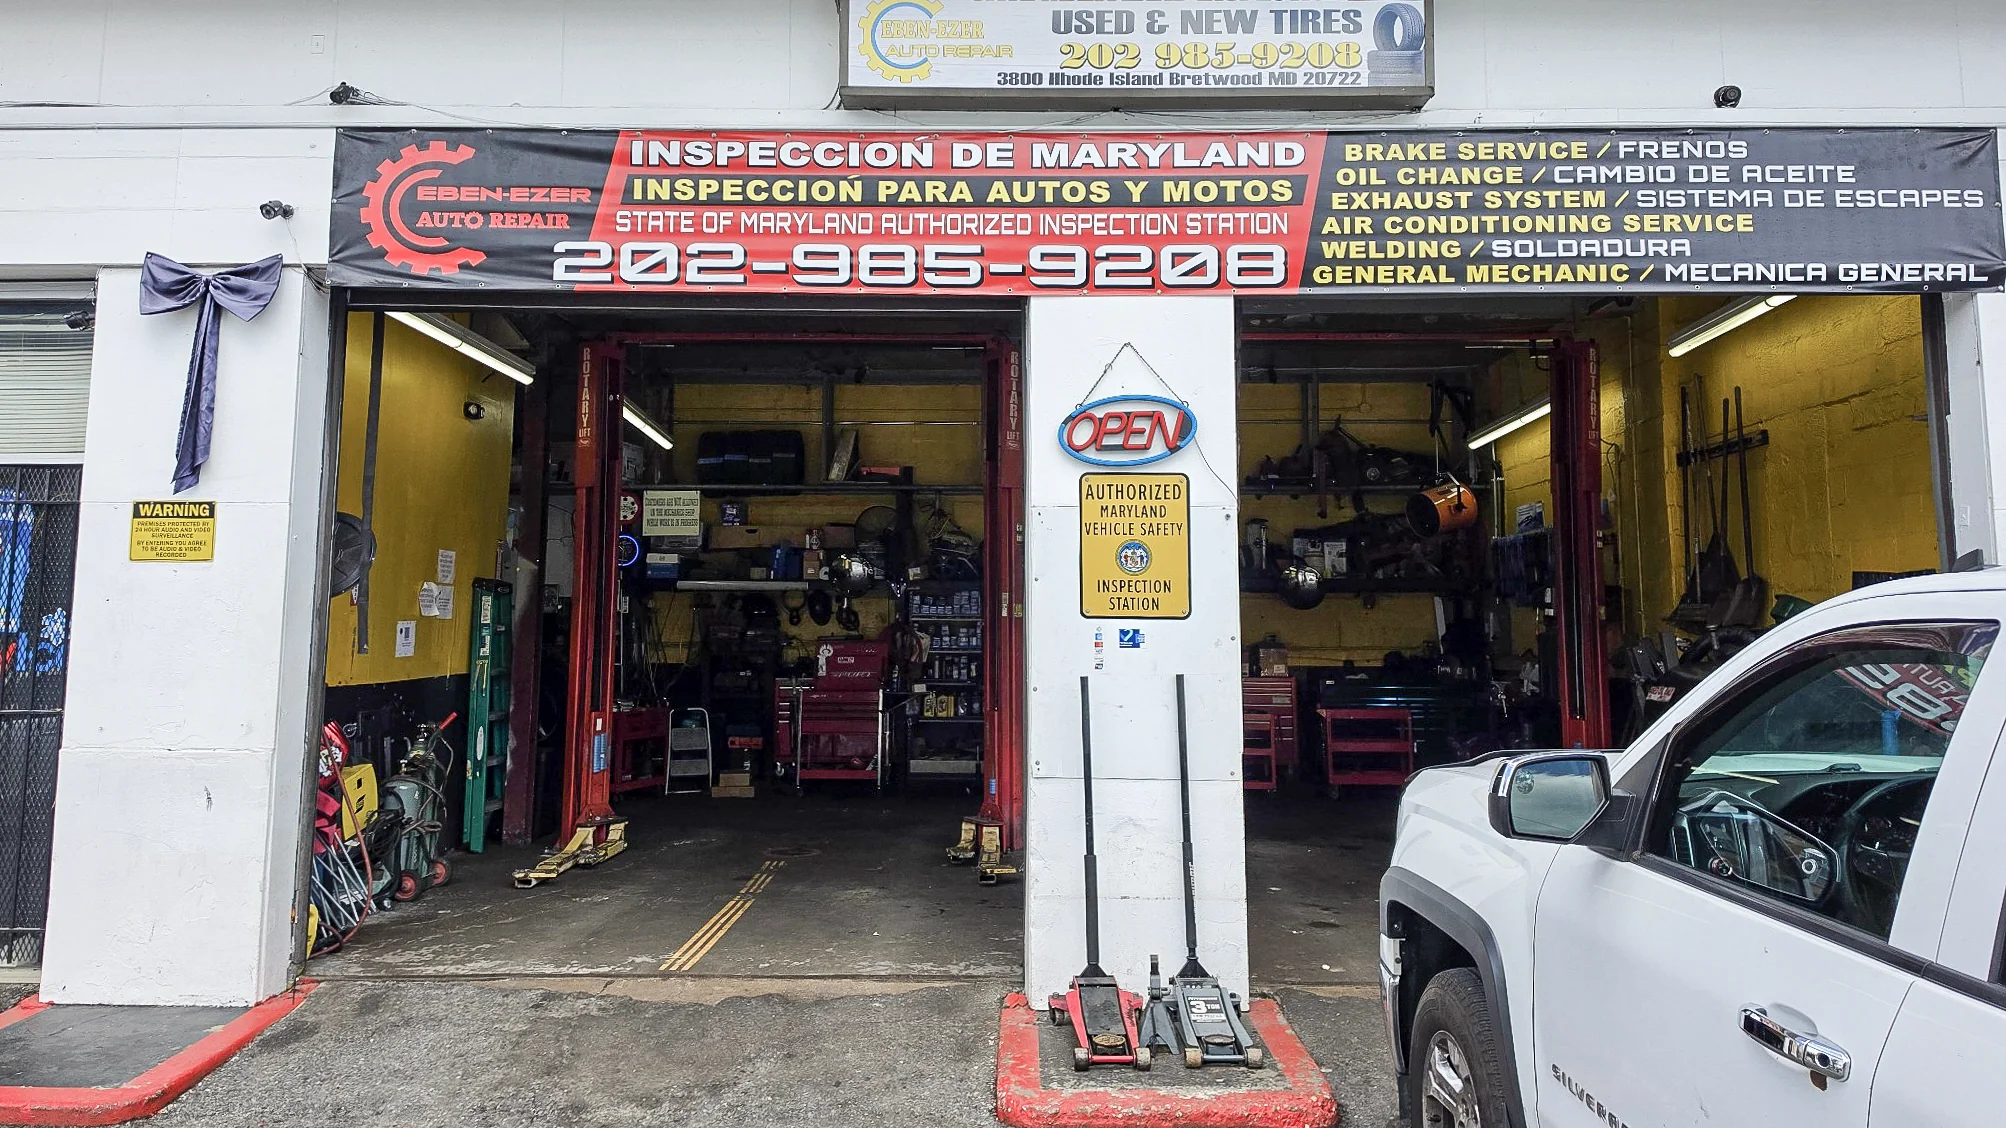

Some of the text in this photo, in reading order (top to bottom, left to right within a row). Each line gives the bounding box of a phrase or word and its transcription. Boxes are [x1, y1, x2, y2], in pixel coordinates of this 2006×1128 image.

[881, 20, 984, 39] EBEN-EZER
[1051, 9, 1362, 35] USED & NEW TIRES
[885, 44, 1013, 58] AUTO REPAIR
[1060, 41, 1362, 69] 202 985-9208
[997, 71, 1362, 86] 3800 Rhode Island Bretwood MD 20722
[952, 142, 1014, 168] DE
[1031, 142, 1306, 168] MARYLAND
[1345, 142, 1447, 161] BRAKE
[1457, 142, 1588, 160] SERVICE
[1619, 140, 1748, 159] FRENOS
[1336, 167, 1386, 186] OIL
[1397, 166, 1524, 185] CHANGE
[1554, 165, 1676, 183] CAMBIO
[1688, 165, 1730, 183] DE
[1742, 165, 1856, 183] ACEITE
[417, 186, 591, 203] EBEN-EZER
[878, 179, 973, 203] PARA
[986, 180, 1111, 203] AUTOS
[1124, 180, 1149, 203] Y
[1163, 179, 1293, 203] MOTOS
[1332, 191, 1474, 210] EXHAUST
[1484, 190, 1606, 209] SYSTEM
[1637, 189, 1774, 208] SISTEMA
[1784, 189, 1825, 208] DE
[1835, 189, 1984, 208] ESCAPES
[416, 211, 570, 230] AUTO REPAIR
[615, 210, 1288, 235] STATE OF MARYLAND AUTHORIZED INSPECTION STATION
[1321, 214, 1754, 235] AIR CONDITIONING SERVICE
[1321, 240, 1462, 259] WELDING
[1491, 238, 1691, 258] SOLDADURA
[552, 241, 1289, 289] 202-985-9208
[1312, 264, 1456, 284] GENERAL
[1466, 263, 1630, 283] MECHANIC
[1665, 263, 1827, 282] MECANICA
[1838, 262, 1988, 282] GENERAL
[581, 347, 590, 428] ROTARY
[1009, 351, 1019, 430] ROTARY
[1589, 348, 1598, 430] ROTARY
[1067, 409, 1185, 453] OPEN
[1085, 484, 1182, 500] AUTHORIZED
[139, 503, 210, 517] WARNING
[1100, 505, 1167, 518] MARYLAND
[1084, 522, 1184, 536] VEHICLE SAFETY
[1097, 579, 1172, 594] INSPECTION
[1109, 597, 1160, 611] STATION
[1190, 1000, 1208, 1014] 3
[1551, 1063, 1630, 1128] SILVERA
